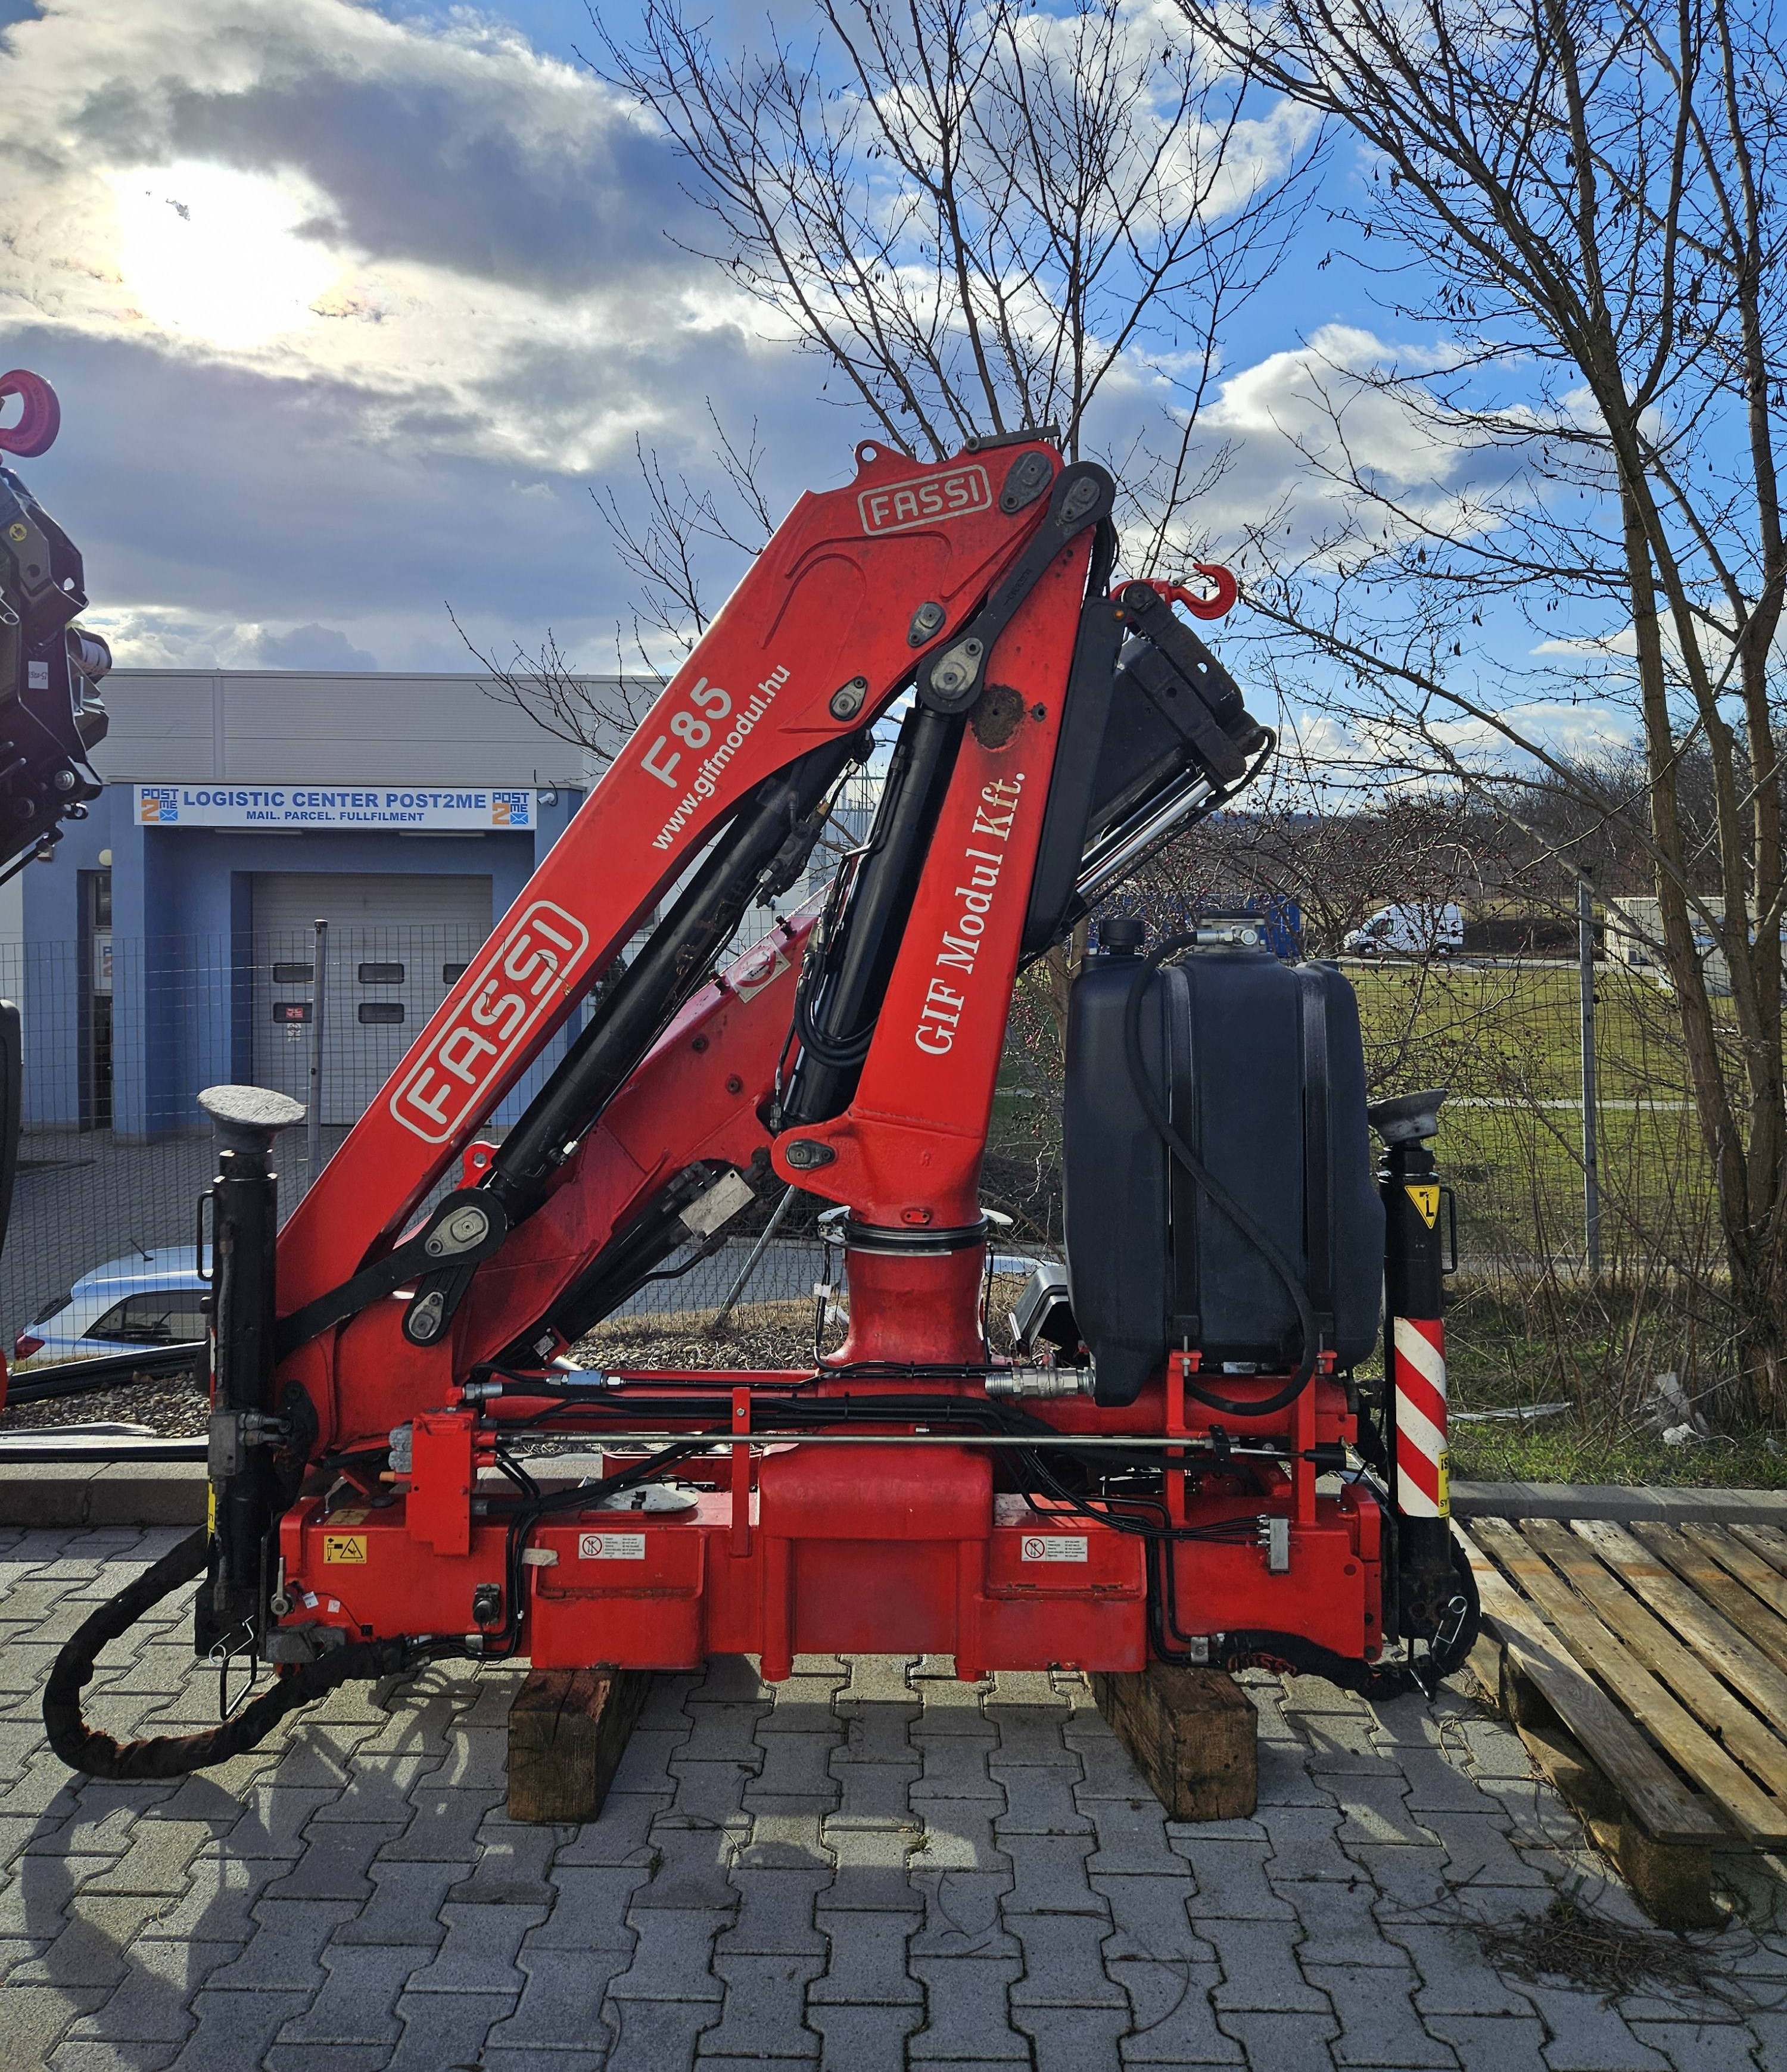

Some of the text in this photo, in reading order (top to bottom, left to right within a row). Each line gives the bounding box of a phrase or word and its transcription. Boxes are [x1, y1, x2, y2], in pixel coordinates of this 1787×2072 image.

[870, 475, 979, 525] FASSI
[640, 677, 732, 789] F 85
[652, 665, 790, 850] www.gifmodul.hu
[141, 789, 179, 799] POST
[183, 792, 486, 808] LOGISTIC CENTER POST2ME
[492, 792, 529, 803] POST
[141, 799, 178, 821] 2 ME
[247, 811, 424, 821] MAIL. PARCEL. FULLFILMENT
[492, 803, 528, 825] 2 ME
[915, 772, 1025, 1055] GIF Modul Kft.
[406, 919, 573, 1124] FASSI
